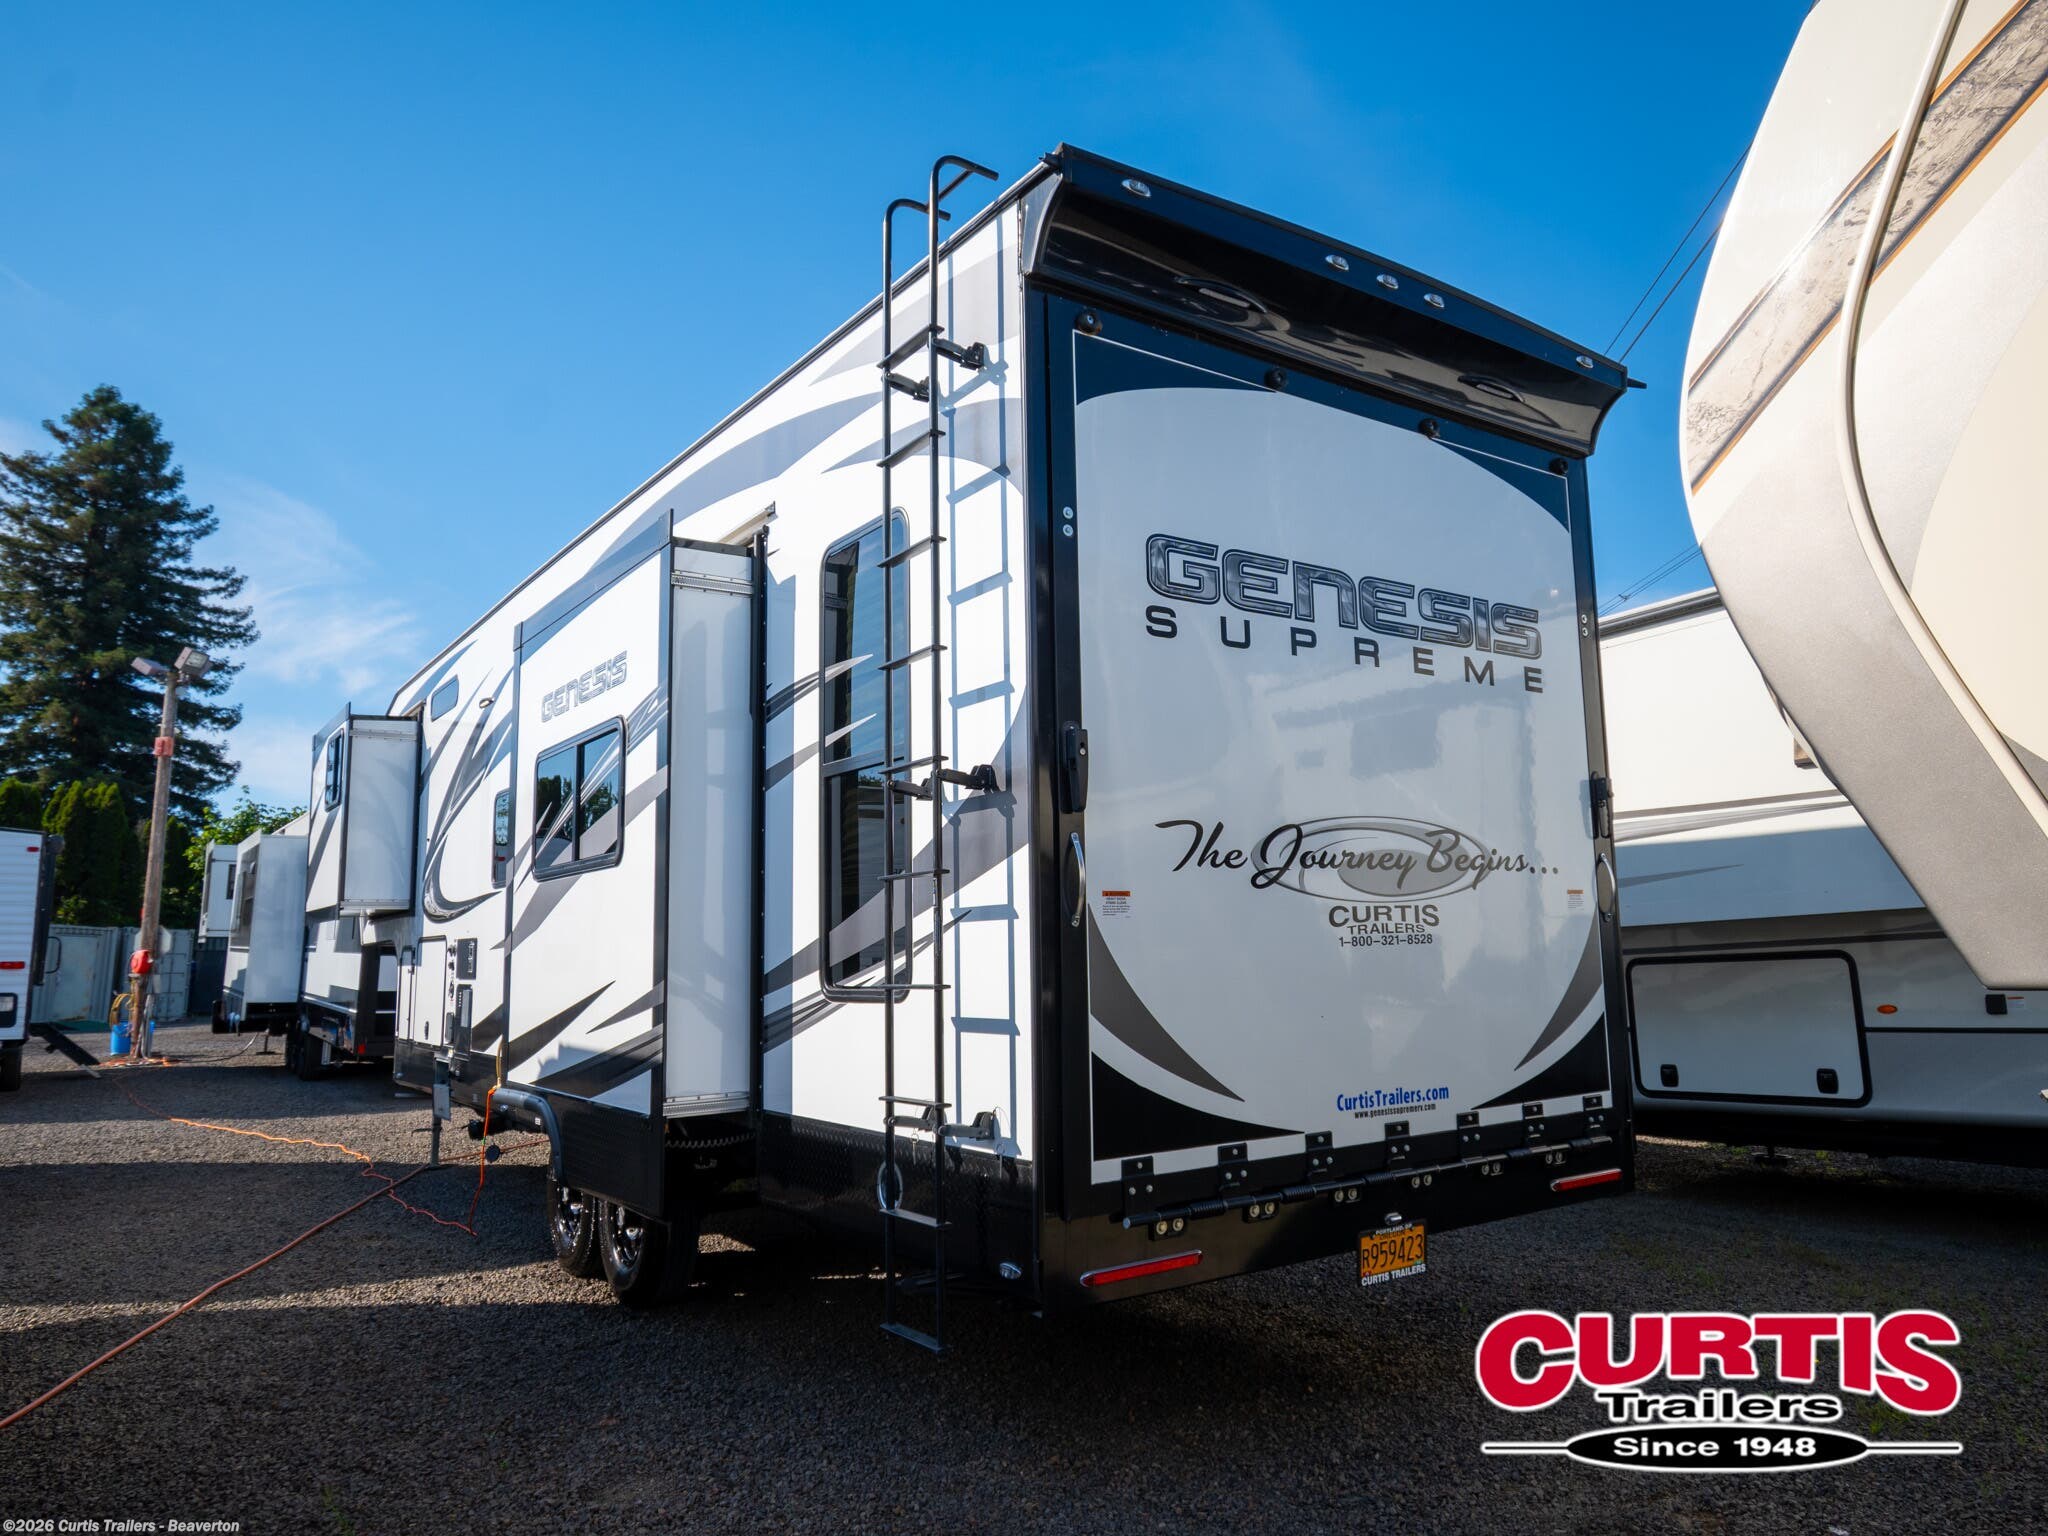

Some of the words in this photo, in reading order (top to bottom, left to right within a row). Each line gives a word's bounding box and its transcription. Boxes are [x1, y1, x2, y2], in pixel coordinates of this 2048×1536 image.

[1145, 533, 1543, 660] GENESIS
[1145, 604, 1544, 693] SUPREME
[541, 650, 628, 723] GENESIS
[1154, 819, 1248, 872] The
[1250, 823, 1417, 890] Journey
[1424, 829, 1559, 890] Begins...
[1328, 903, 1440, 928] CURTIS
[1346, 922, 1426, 935] TRAILERS
[1338, 933, 1434, 948] 1-800-321-8528
[1336, 1086, 1450, 1112] CurtisTrailers.com
[1362, 1233, 1424, 1270] R959423
[1361, 1271, 1390, 1287] CURTIS
[1391, 1263, 1427, 1279] TRAILERS
